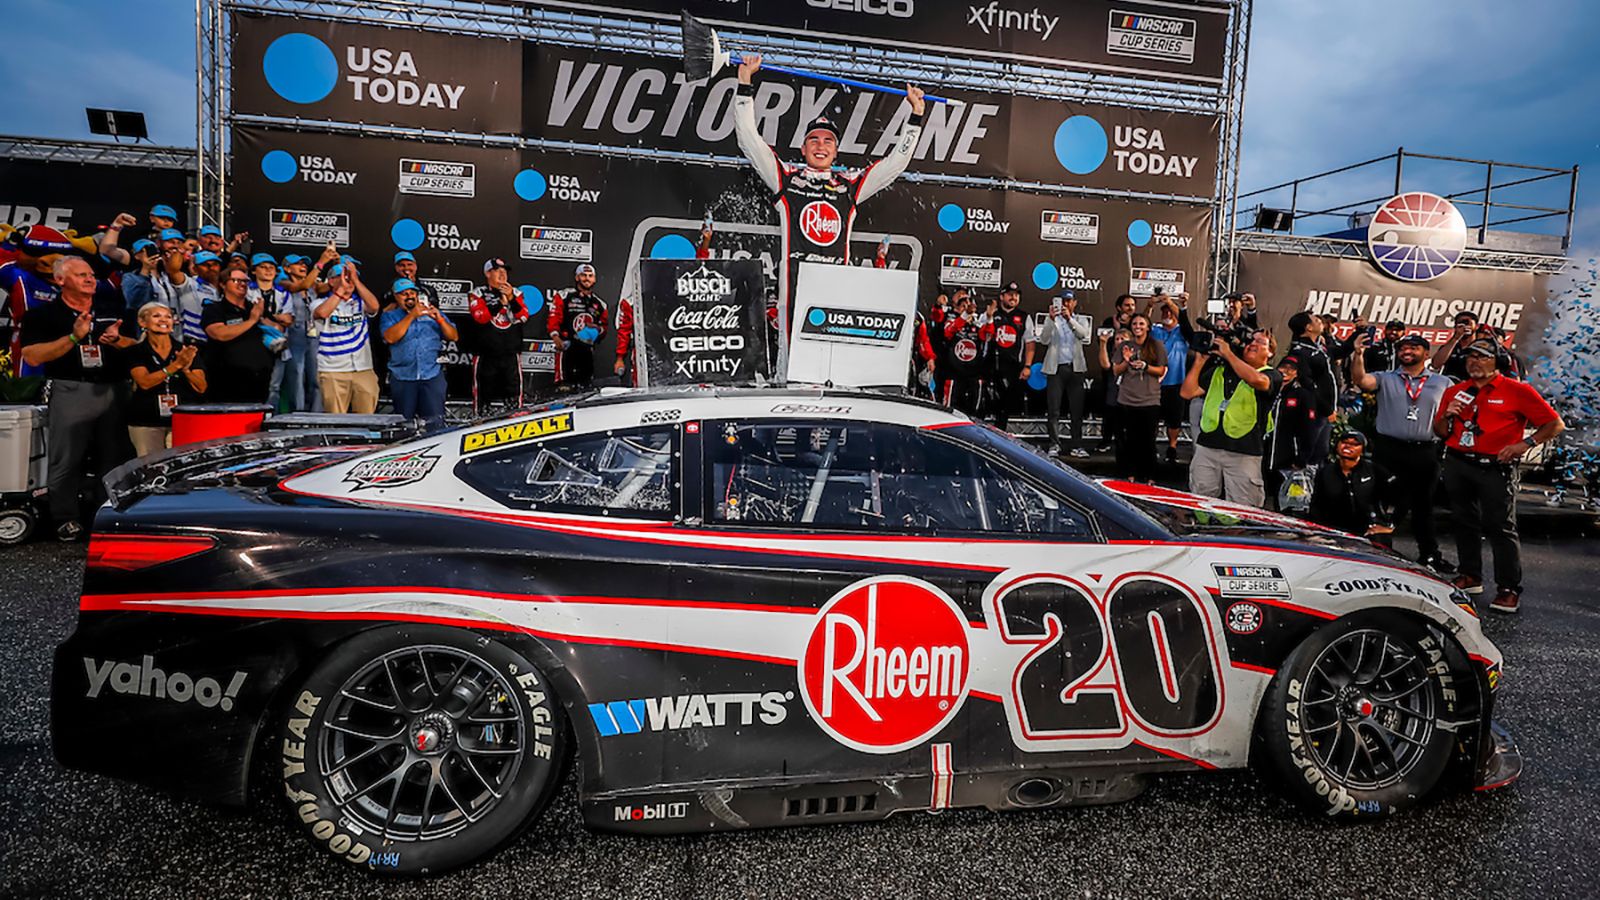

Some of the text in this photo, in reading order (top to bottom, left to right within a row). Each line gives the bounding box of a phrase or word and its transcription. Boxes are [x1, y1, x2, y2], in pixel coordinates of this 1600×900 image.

[968, 1, 1060, 41] xfinity
[1136, 17, 1184, 34] NASCAR
[1119, 34, 1183, 52] CUP SERIES
[346, 46, 418, 77] USA
[346, 76, 466, 110] TODAY
[547, 59, 1000, 165] VICTORY LANE
[1113, 125, 1167, 152] USA
[300, 155, 334, 171] USA
[424, 163, 464, 176] NASCAR
[1113, 150, 1199, 178] TODAY
[300, 169, 357, 185] TODAY
[409, 177, 464, 190] CUP SERIES
[549, 175, 581, 189] USA
[549, 187, 600, 203] TODAY
[295, 215, 338, 227] NASCAR
[806, 203, 839, 239] Rheem
[966, 208, 993, 222] USA
[1061, 213, 1091, 226] NASCAR
[281, 227, 339, 240] CUP SERIES
[427, 223, 460, 238] USA
[966, 219, 1010, 234] TODAY
[1154, 223, 1179, 236] USA
[543, 229, 583, 242] NASCAR
[1154, 233, 1193, 248] TODAY
[427, 236, 481, 251] TODAY
[529, 242, 583, 255] CUP SERIES
[960, 258, 993, 269] NASCAR
[1060, 265, 1085, 279] USA
[677, 278, 732, 296] BUSCH
[1060, 276, 1101, 291] TODAY
[440, 296, 463, 307] RIES
[688, 294, 721, 302] LIGHT
[667, 304, 743, 331] Coca-Cola
[1303, 289, 1524, 332] NEW HAMPSHIRE
[828, 313, 901, 330] USA TODAY
[875, 330, 897, 340] 301
[669, 335, 744, 352] GEICO
[675, 354, 742, 379] xfinity
[361, 459, 428, 470] INTERSTATE
[354, 468, 420, 478] BATTERIES
[1236, 567, 1273, 578] NASCAR
[1228, 580, 1279, 592] CUP SERIES
[1231, 604, 1258, 616] NASCAR
[822, 584, 964, 723] Rheem
[993, 571, 1225, 741] 20
[1418, 636, 1457, 703] EAGLE
[83, 654, 249, 712] yahoo!
[515, 672, 554, 761] EAGLE
[645, 691, 791, 732] WATTS
[614, 804, 666, 821] Mobil
